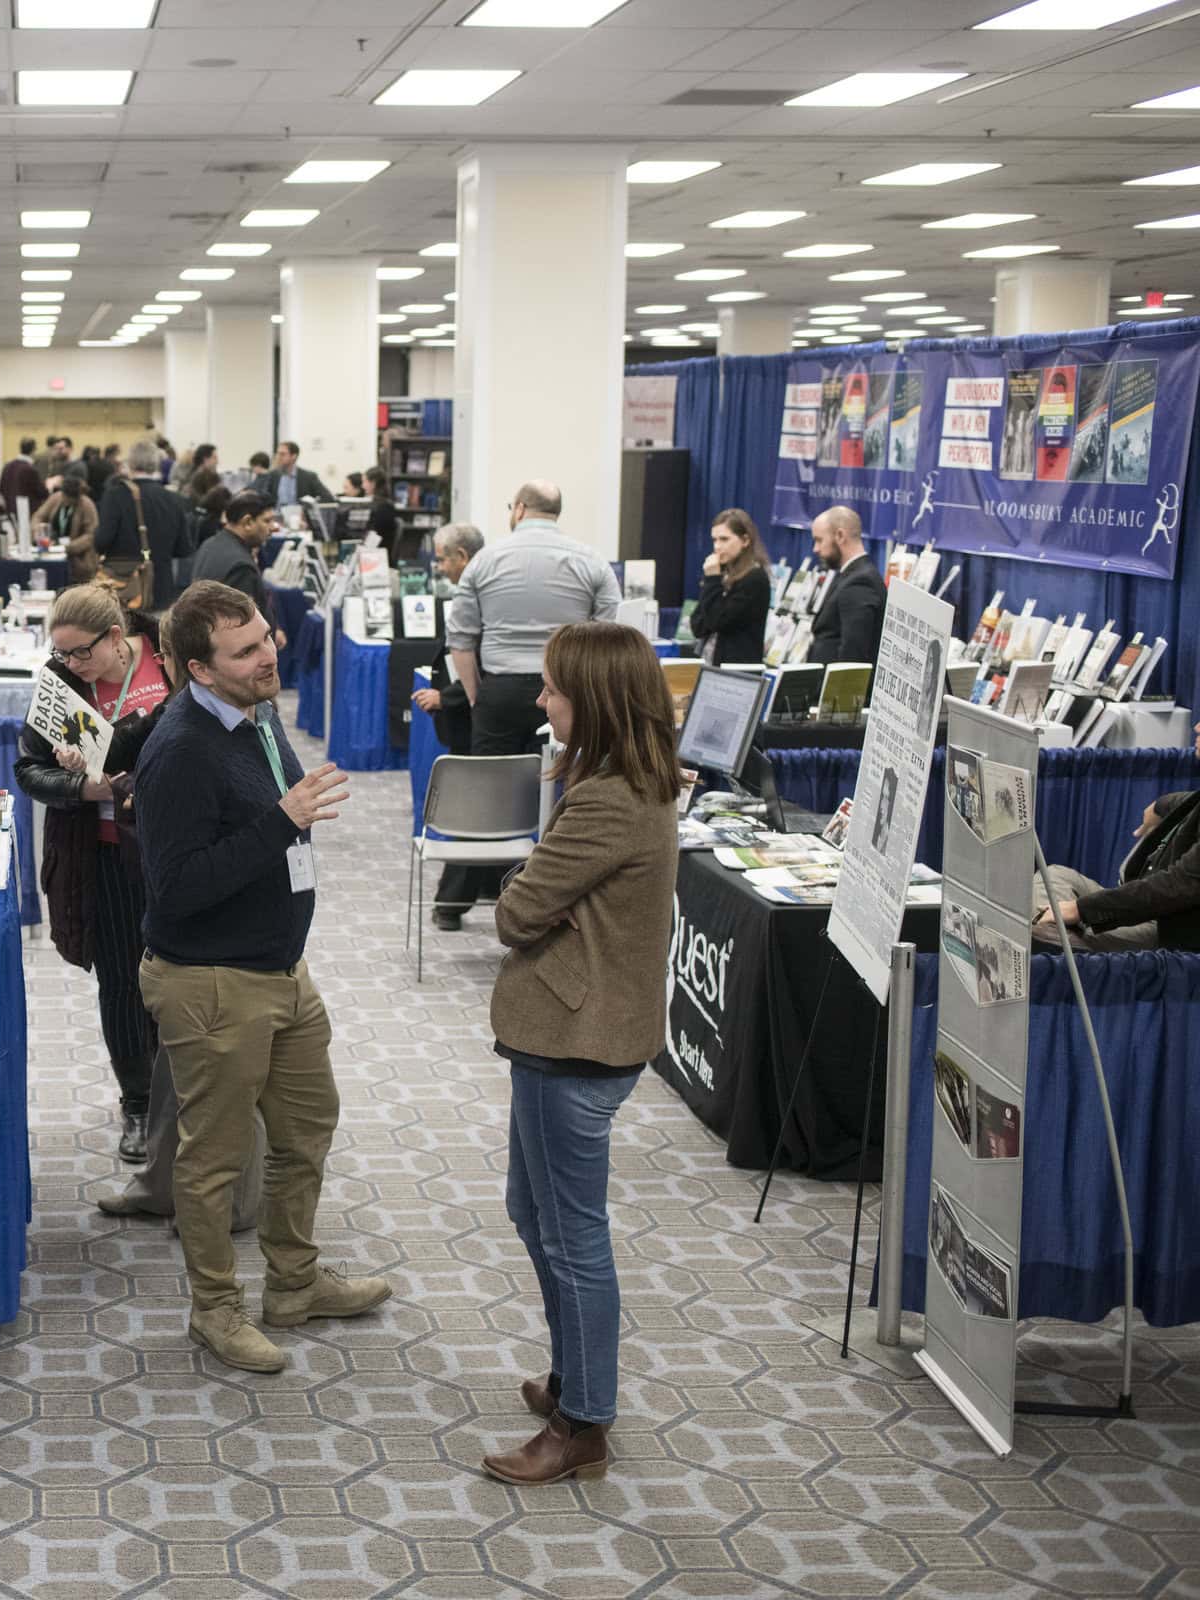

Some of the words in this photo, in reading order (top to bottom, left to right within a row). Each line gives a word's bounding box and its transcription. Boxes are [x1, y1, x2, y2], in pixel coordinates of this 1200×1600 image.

[1069, 506, 1146, 528] ACADEMIC
[33, 673, 55, 731] BASIC
[49, 679, 68, 744] BOOKS
[103, 681, 166, 710] PYNGYANG
[679, 1029, 699, 1073] Start
